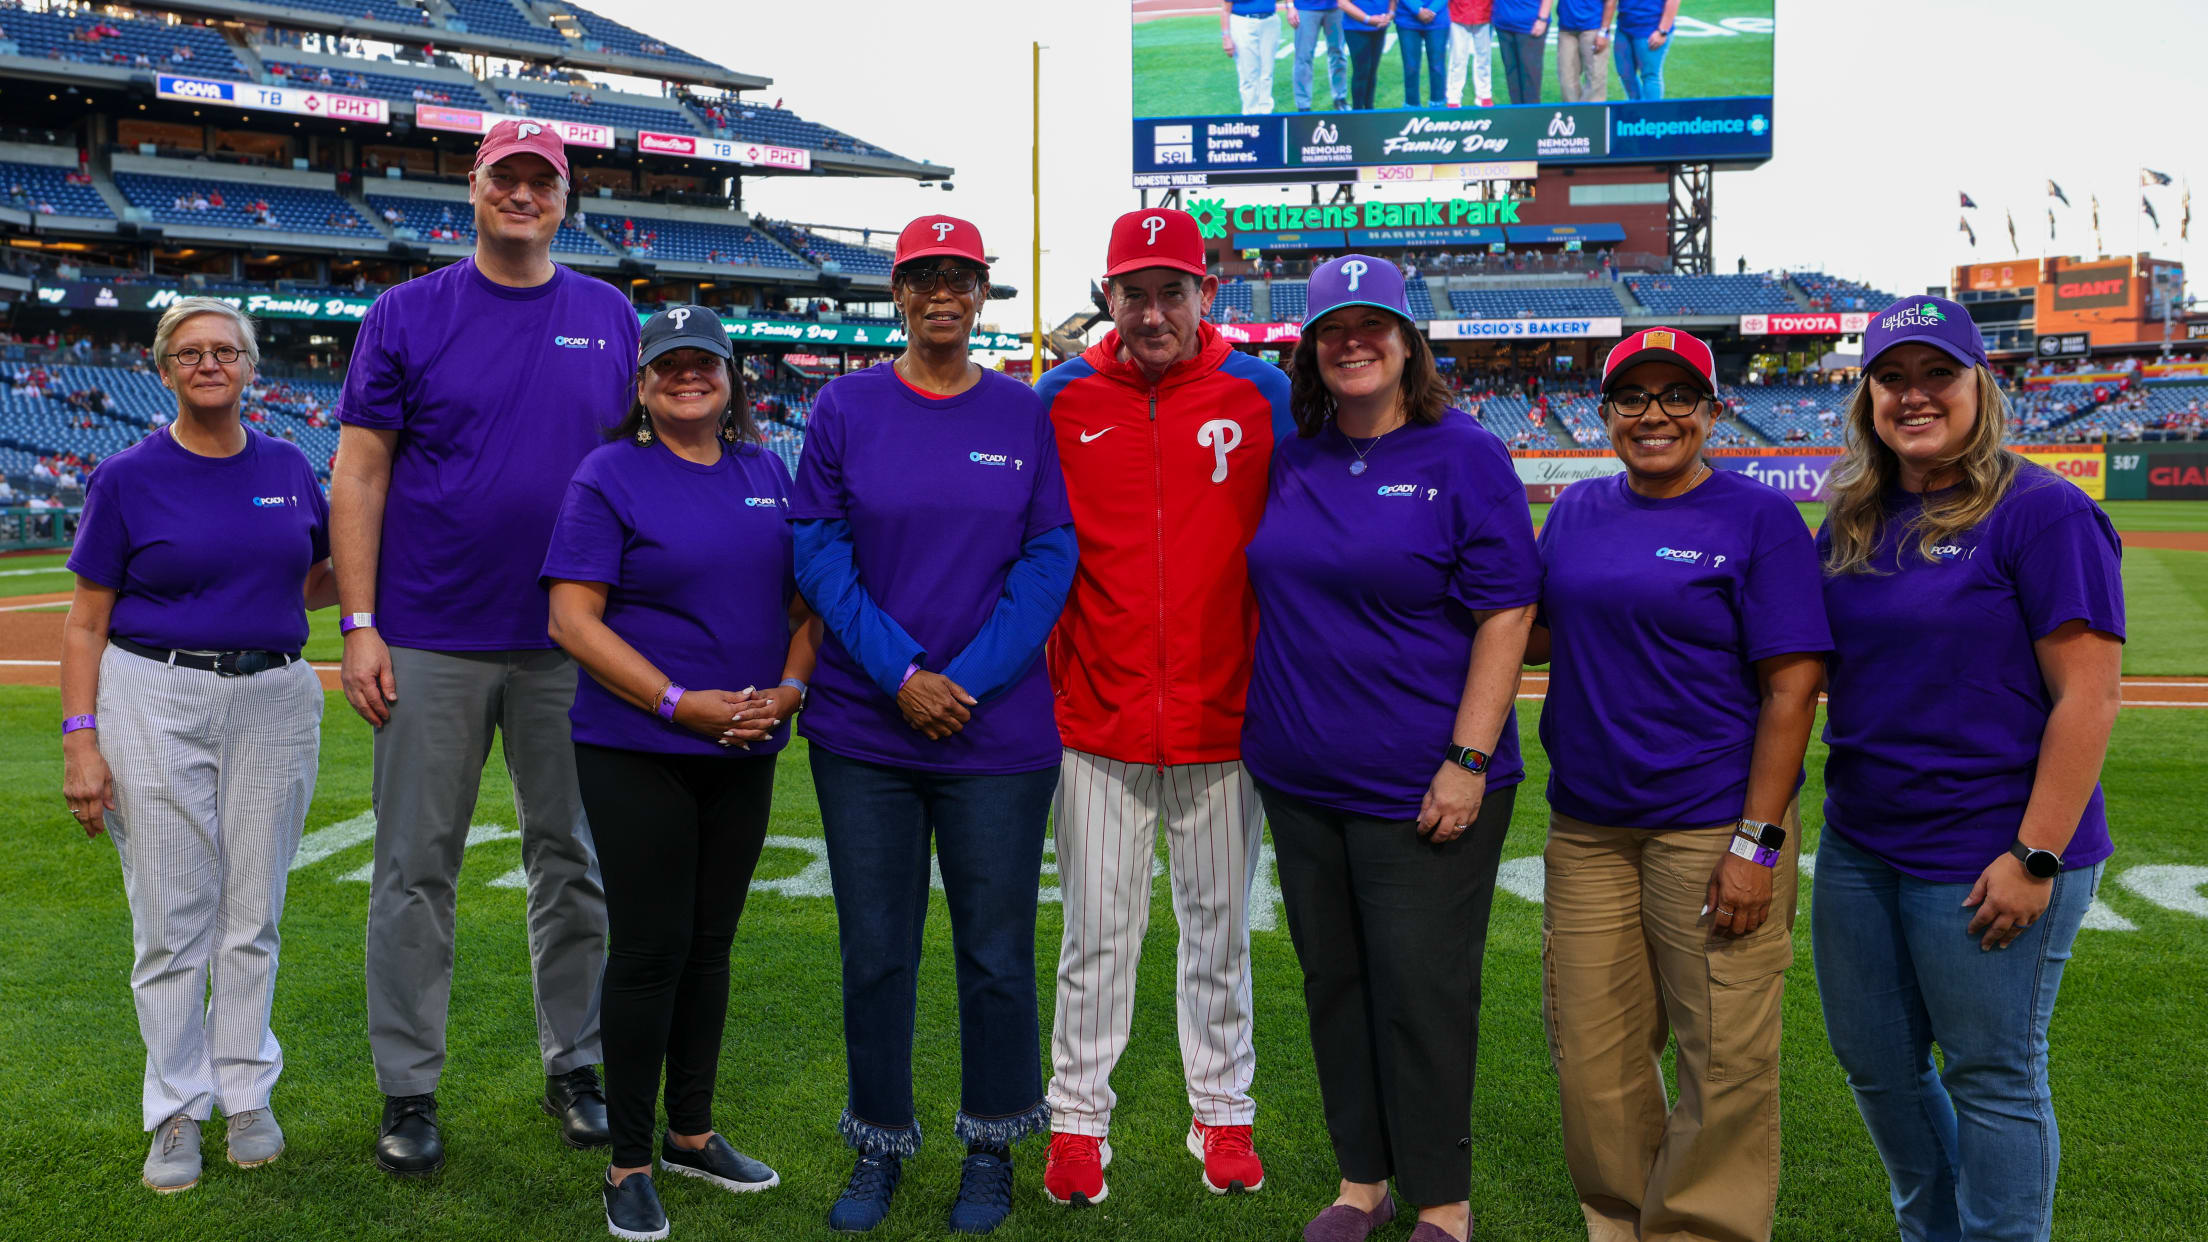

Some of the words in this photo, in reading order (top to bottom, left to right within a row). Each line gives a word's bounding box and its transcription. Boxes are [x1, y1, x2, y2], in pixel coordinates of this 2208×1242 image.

[172, 80, 221, 98] GOYA
[258, 90, 282, 105] TB
[335, 100, 370, 116] PHI
[569, 127, 599, 141] PHI
[1207, 123, 1260, 138] Building
[1399, 117, 1492, 136] Nemours
[1617, 116, 1744, 139] Independence
[713, 143, 731, 156] TB
[1207, 138, 1243, 150] brave
[1302, 145, 1352, 155] NEMOURS
[1384, 136, 1456, 155] Family
[1462, 134, 1509, 152] Day
[1537, 138, 1590, 147] NEMOURS
[770, 151, 797, 164] PHI
[1134, 175, 1171, 187] DOMESTIC
[1172, 174, 1207, 185] VIOLENCE
[1233, 203, 1359, 231] Citizens
[1364, 197, 1445, 227] Bank
[1448, 193, 1521, 225] Park
[931, 222, 955, 242] P
[1141, 216, 1166, 246] P
[1368, 230, 1427, 239] HARRY
[1340, 260, 1369, 292] P
[2058, 279, 2124, 299] GIANT
[248, 295, 319, 315] Family
[325, 297, 367, 317] Day
[667, 308, 691, 330] P
[1771, 317, 1837, 331] TOYOTA
[1881, 304, 1920, 330] Laurel
[751, 322, 803, 338] Family
[807, 325, 838, 340] Day
[1458, 323, 1523, 336] LISCIO'S
[1529, 321, 1591, 334] BAKERY
[995, 334, 1020, 348] Day
[1196, 418, 1243, 484] P
[1540, 450, 1604, 458] ASPLUNDH
[2113, 455, 2140, 470] 387
[1737, 461, 1830, 497] finity
